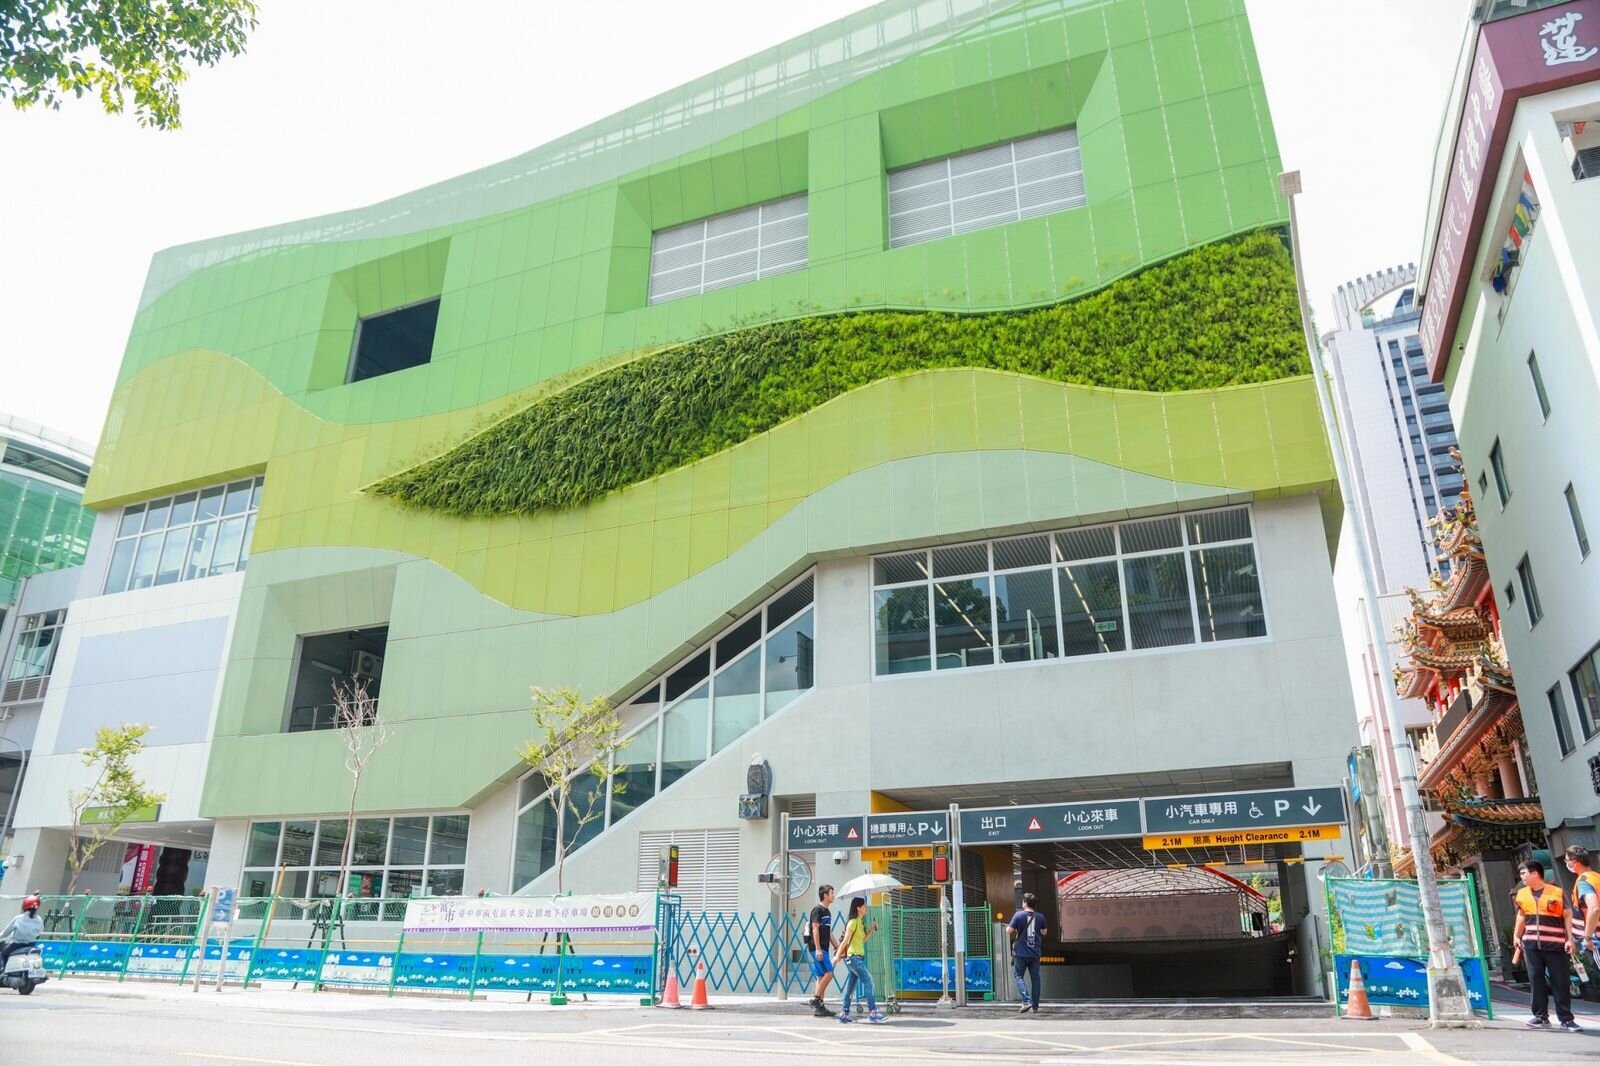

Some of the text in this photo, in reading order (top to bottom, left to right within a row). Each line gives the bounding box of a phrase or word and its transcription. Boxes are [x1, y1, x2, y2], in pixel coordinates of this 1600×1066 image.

[1165, 799, 1290, 819] 小汽車專用 P
[981, 816, 1007, 829] 出口
[1063, 808, 1119, 825] 小心來車
[792, 824, 839, 838] 小心來車
[870, 822, 929, 836] 機車專用 P
[1162, 830, 1320, 846] 2.1M 限高 Height Clearance 2.1M
[882, 850, 924, 858] 1.9M 限高
